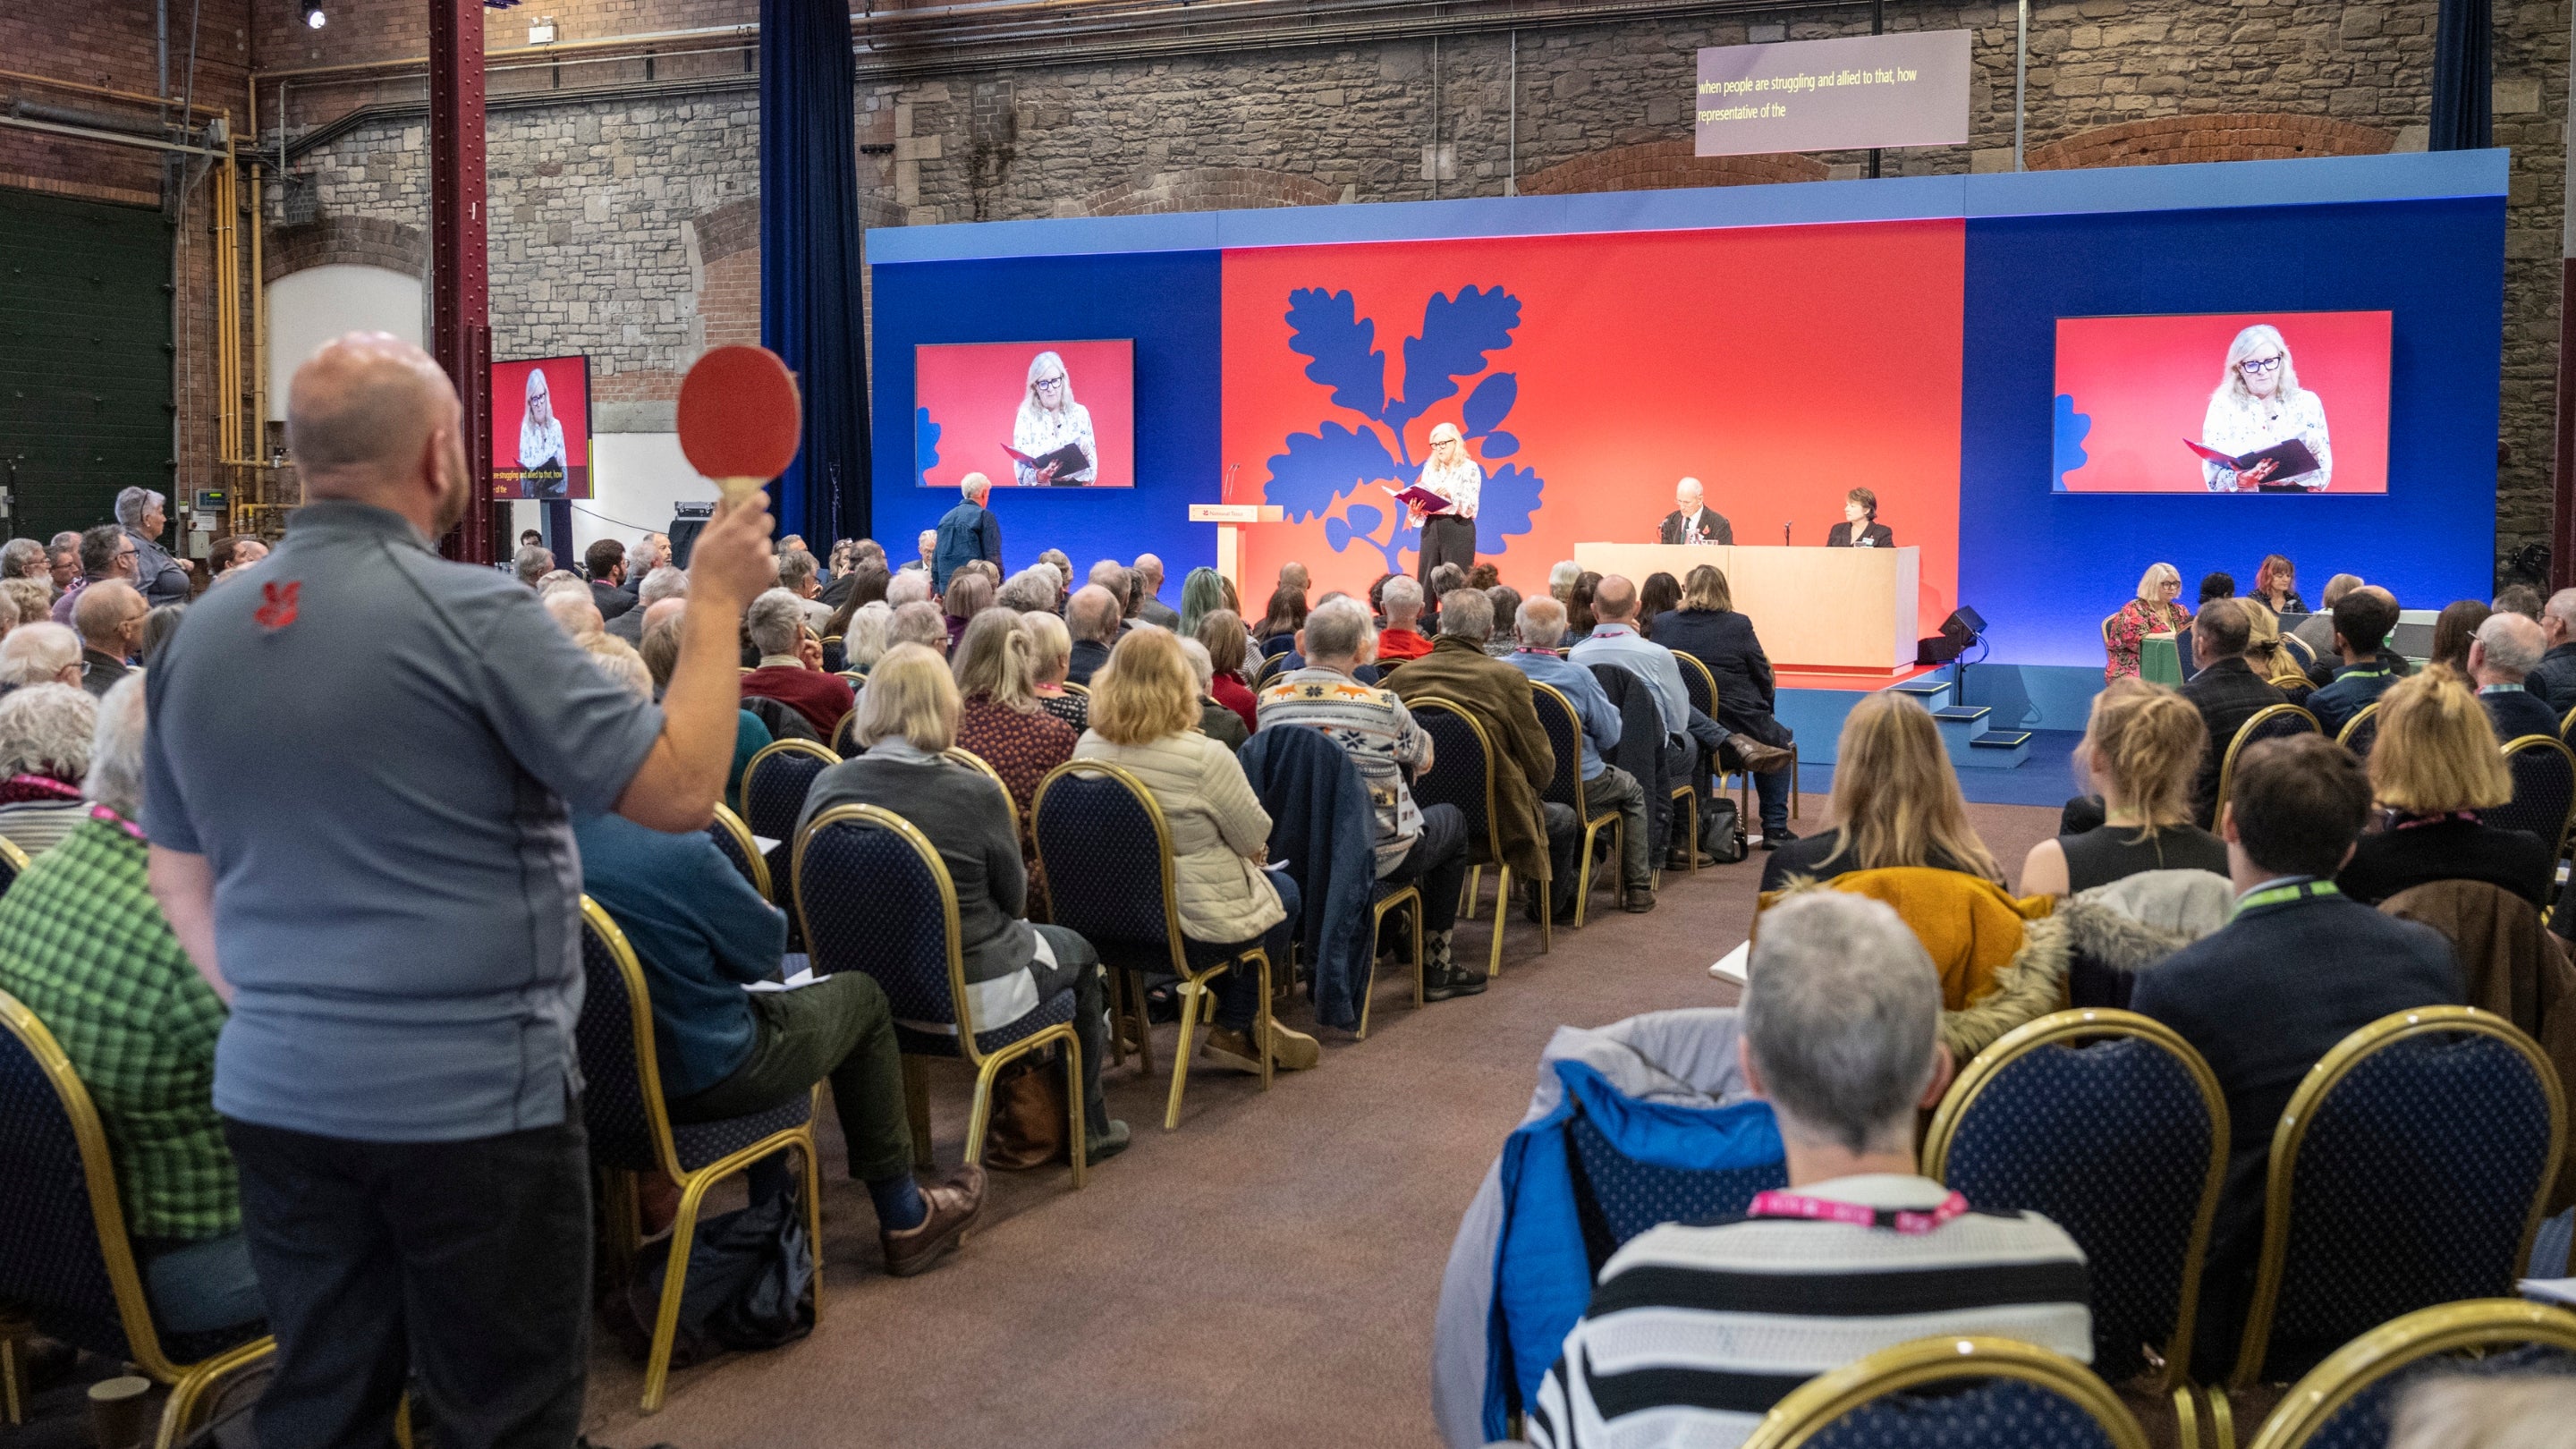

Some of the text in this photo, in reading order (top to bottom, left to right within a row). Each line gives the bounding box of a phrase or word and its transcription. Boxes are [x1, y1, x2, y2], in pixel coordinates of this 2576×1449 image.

[1699, 67, 1918, 97] when people are struggling and allied to that, how
[1698, 102, 1786, 124] representative of the
